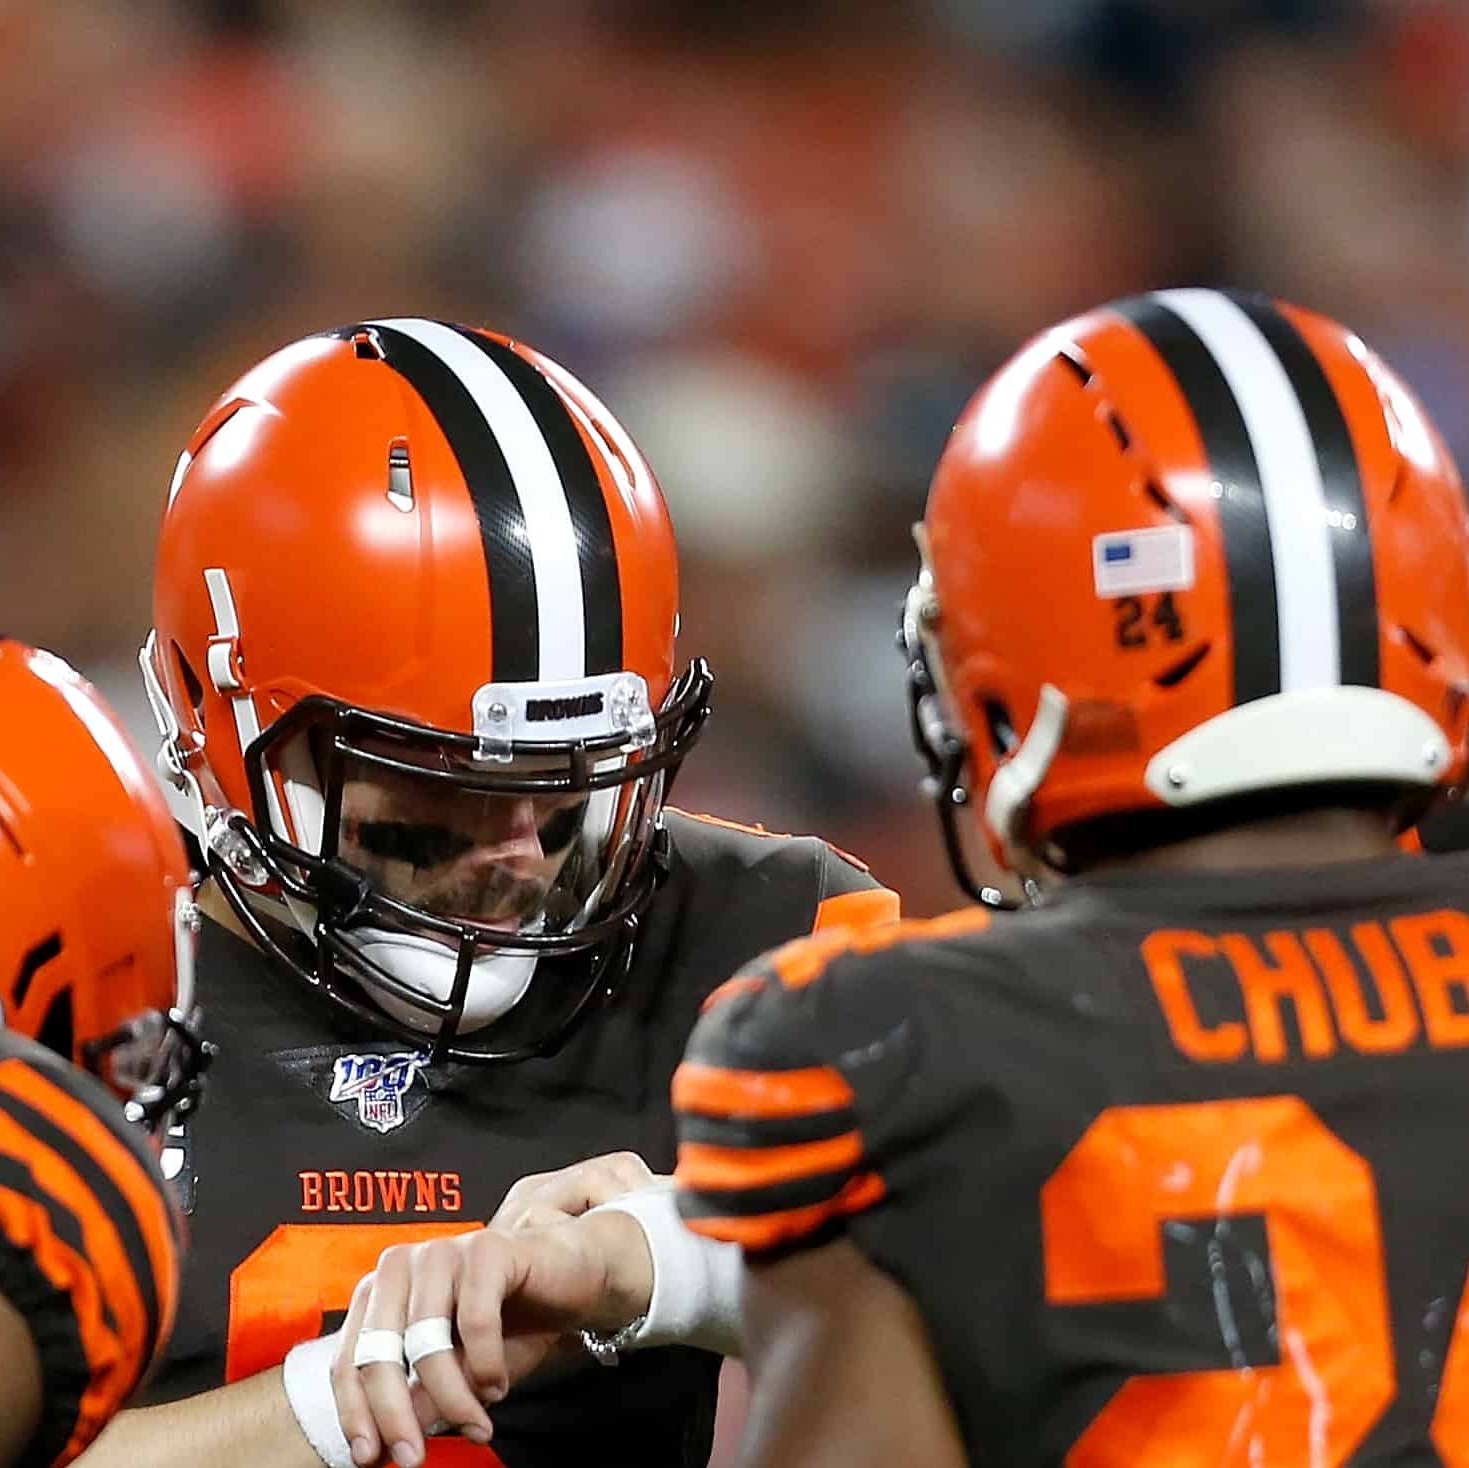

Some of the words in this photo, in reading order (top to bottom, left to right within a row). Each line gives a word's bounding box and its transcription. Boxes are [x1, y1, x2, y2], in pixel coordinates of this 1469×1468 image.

[1114, 591, 1183, 647] 24
[1140, 908, 1469, 1064] CHUB
[368, 1102, 396, 1120] NFL
[298, 1170, 462, 1213] BROWNS
